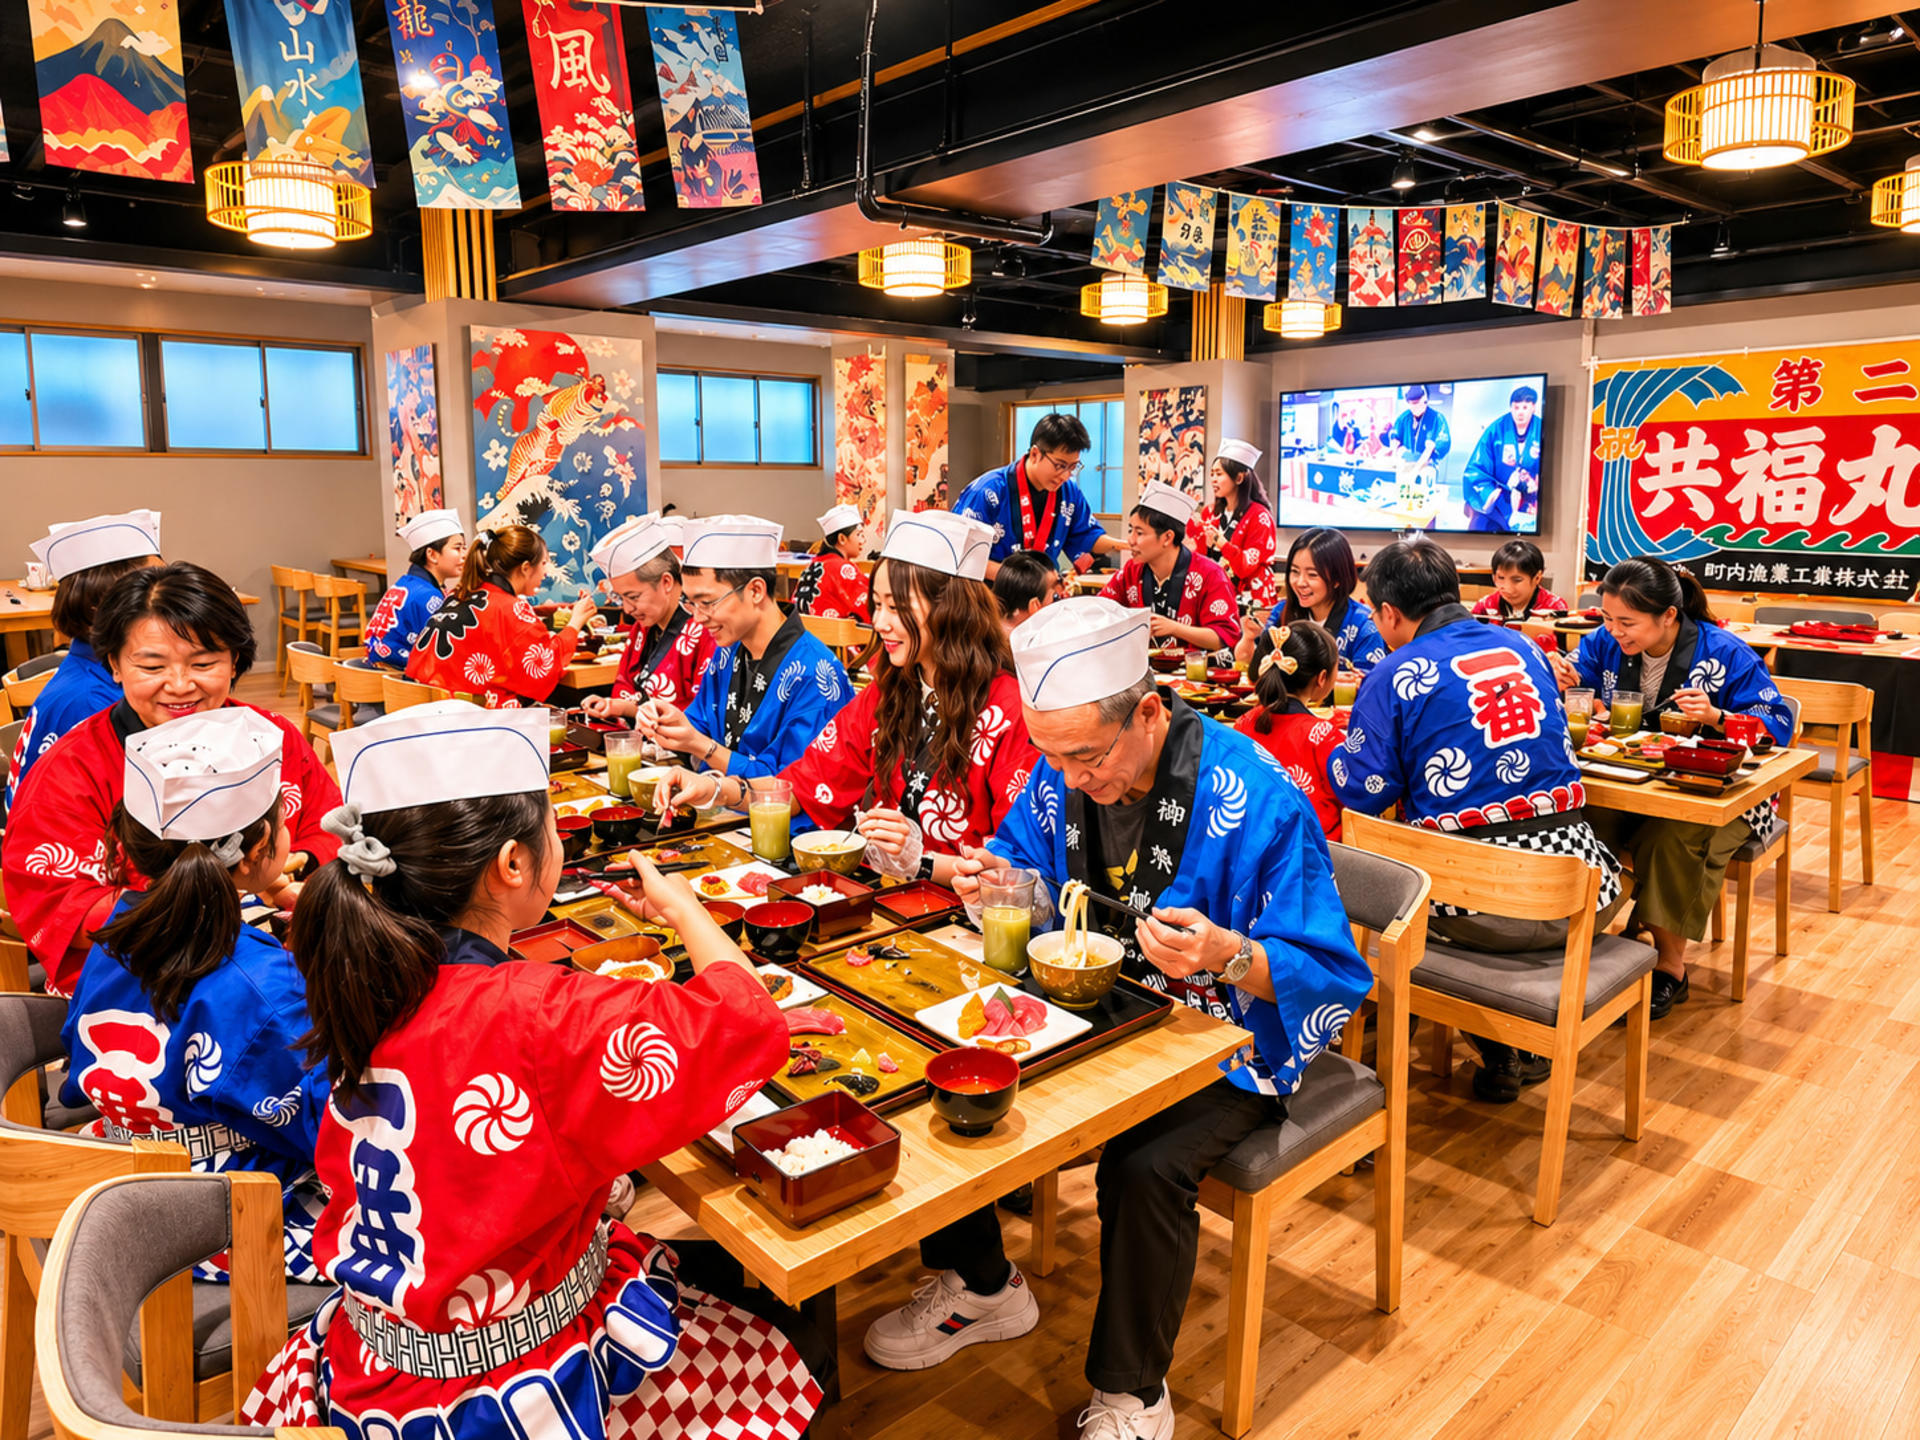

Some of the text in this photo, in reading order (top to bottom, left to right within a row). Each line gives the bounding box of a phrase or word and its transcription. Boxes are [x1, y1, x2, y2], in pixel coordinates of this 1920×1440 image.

[278, 27, 325, 107] 山水
[548, 29, 611, 94] 風
[1594, 427, 1645, 461] 祝
[1638, 424, 1920, 528] 共福丸
[1452, 648, 1546, 748] 一番
